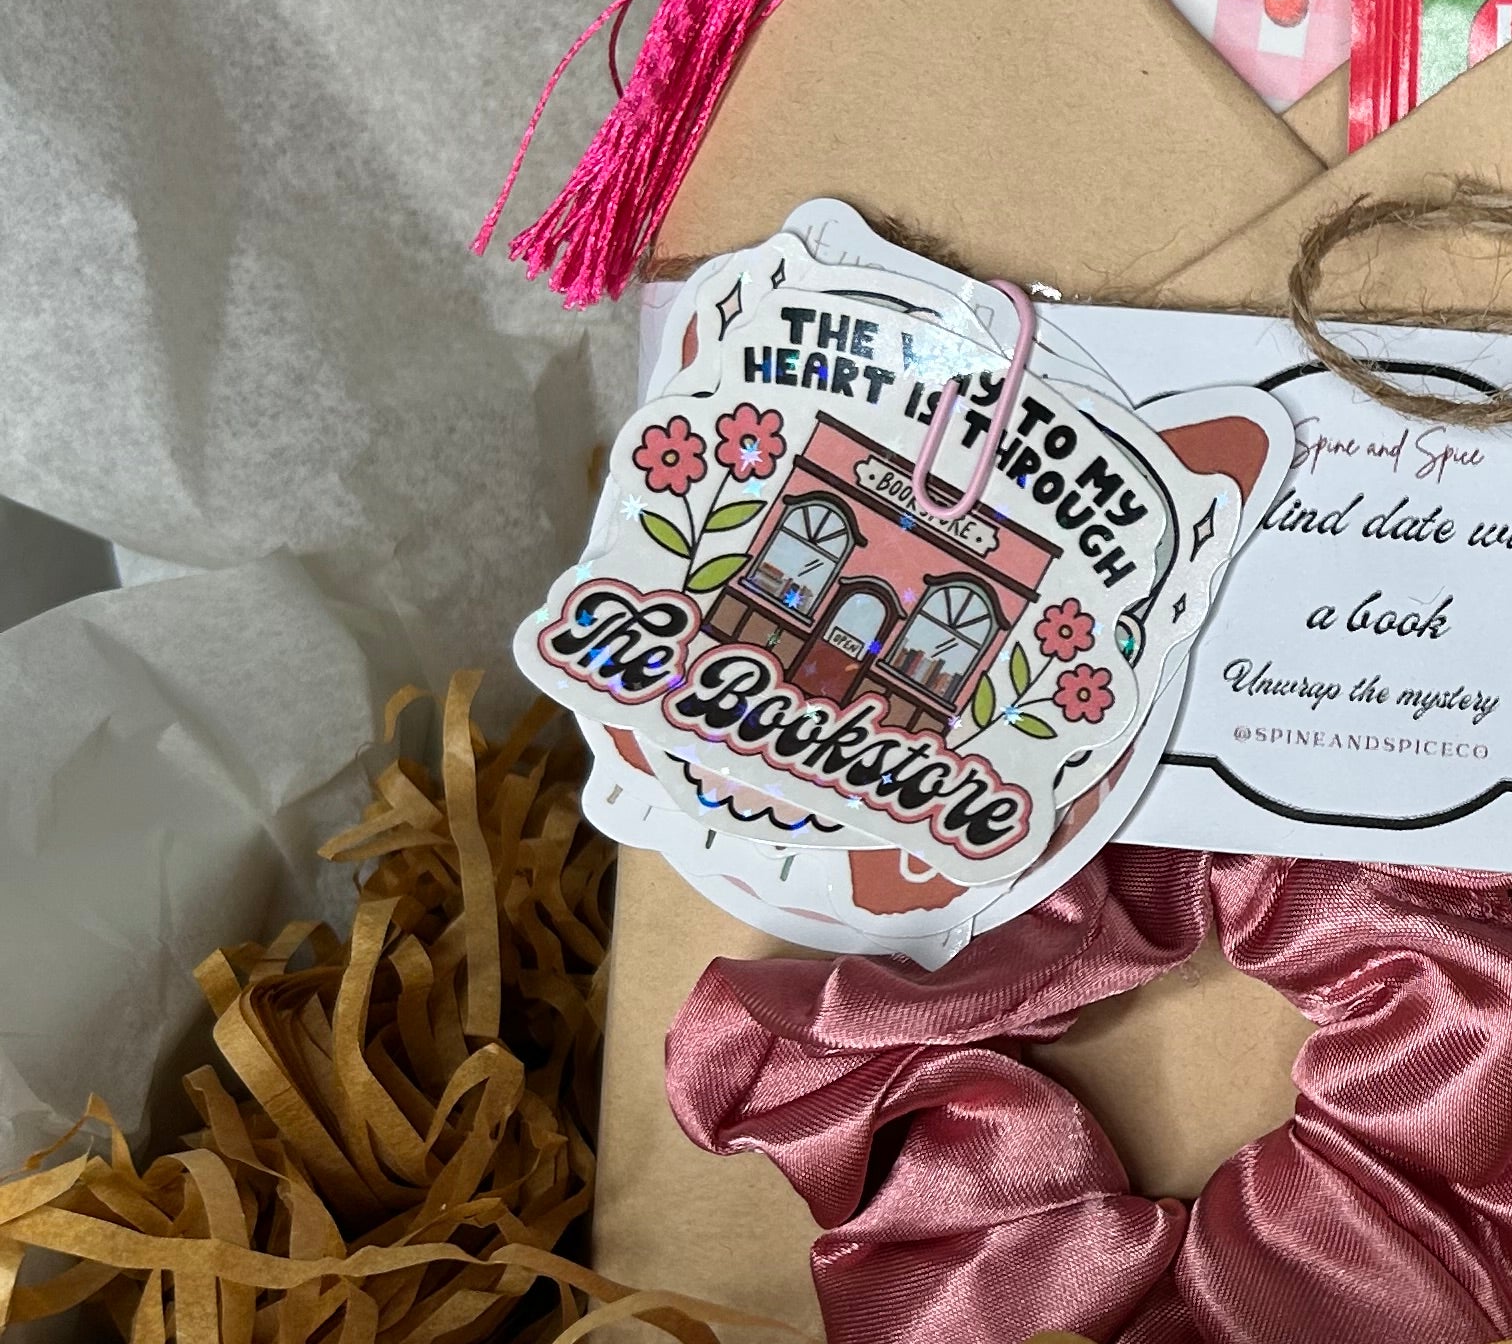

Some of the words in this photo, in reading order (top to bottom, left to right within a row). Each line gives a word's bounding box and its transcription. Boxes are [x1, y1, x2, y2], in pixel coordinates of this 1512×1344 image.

[780, 306, 880, 356] THE
[1019, 396, 1078, 460] TO
[1075, 455, 1149, 527] MY
[1289, 415, 1360, 475] Spine
[1366, 428, 1409, 473] and
[1415, 424, 1485, 484] Spice
[743, 346, 896, 406] HEART
[961, 408, 1138, 588] THROUGH
[1261, 486, 1365, 536] lind
[1361, 495, 1457, 544] date
[1305, 605, 1339, 631] a
[1346, 589, 1454, 640] book
[550, 591, 689, 692] The
[674, 655, 1019, 846] Bookstore
[1222, 657, 1343, 711] Unwrap
[1348, 674, 1392, 705] the
[1396, 685, 1502, 726] mystery
[1232, 725, 1490, 760] @SPINEANDSPICECO
